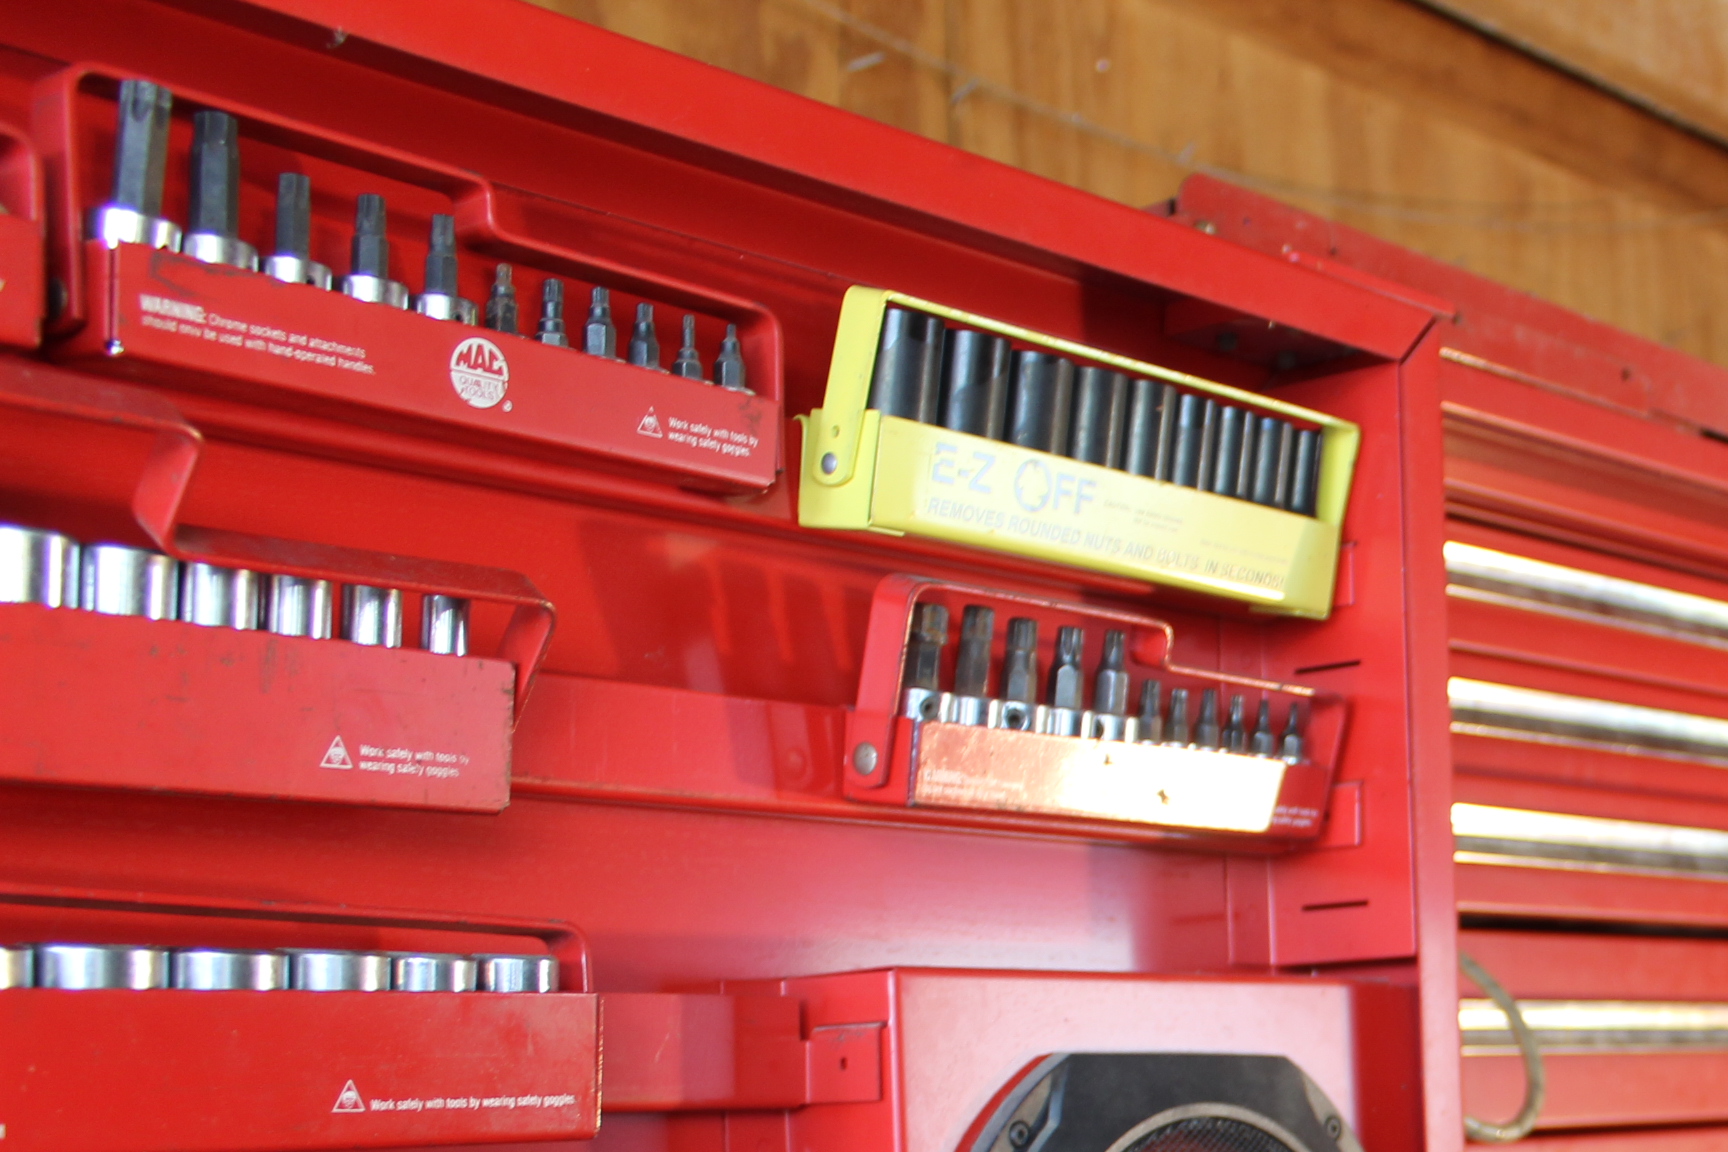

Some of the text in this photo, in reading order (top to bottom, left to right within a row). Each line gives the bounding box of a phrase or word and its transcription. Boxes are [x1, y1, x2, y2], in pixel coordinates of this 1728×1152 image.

[288, 332, 308, 346] and
[456, 343, 504, 376] MAC
[932, 441, 1097, 515] E-Z OFF
[927, 496, 1006, 528] REMOVES
[1007, 515, 1081, 545] ROUNDED
[1084, 531, 1121, 554] NUTS
[1123, 543, 1154, 560] AND
[1156, 549, 1200, 570] BOLTS
[1204, 559, 1219, 574] IN
[370, 1098, 396, 1111] Work
[425, 1097, 444, 1110] with
[446, 1097, 467, 1109] tools
[469, 1096, 480, 1110] by
[482, 1095, 515, 1110] wearing
